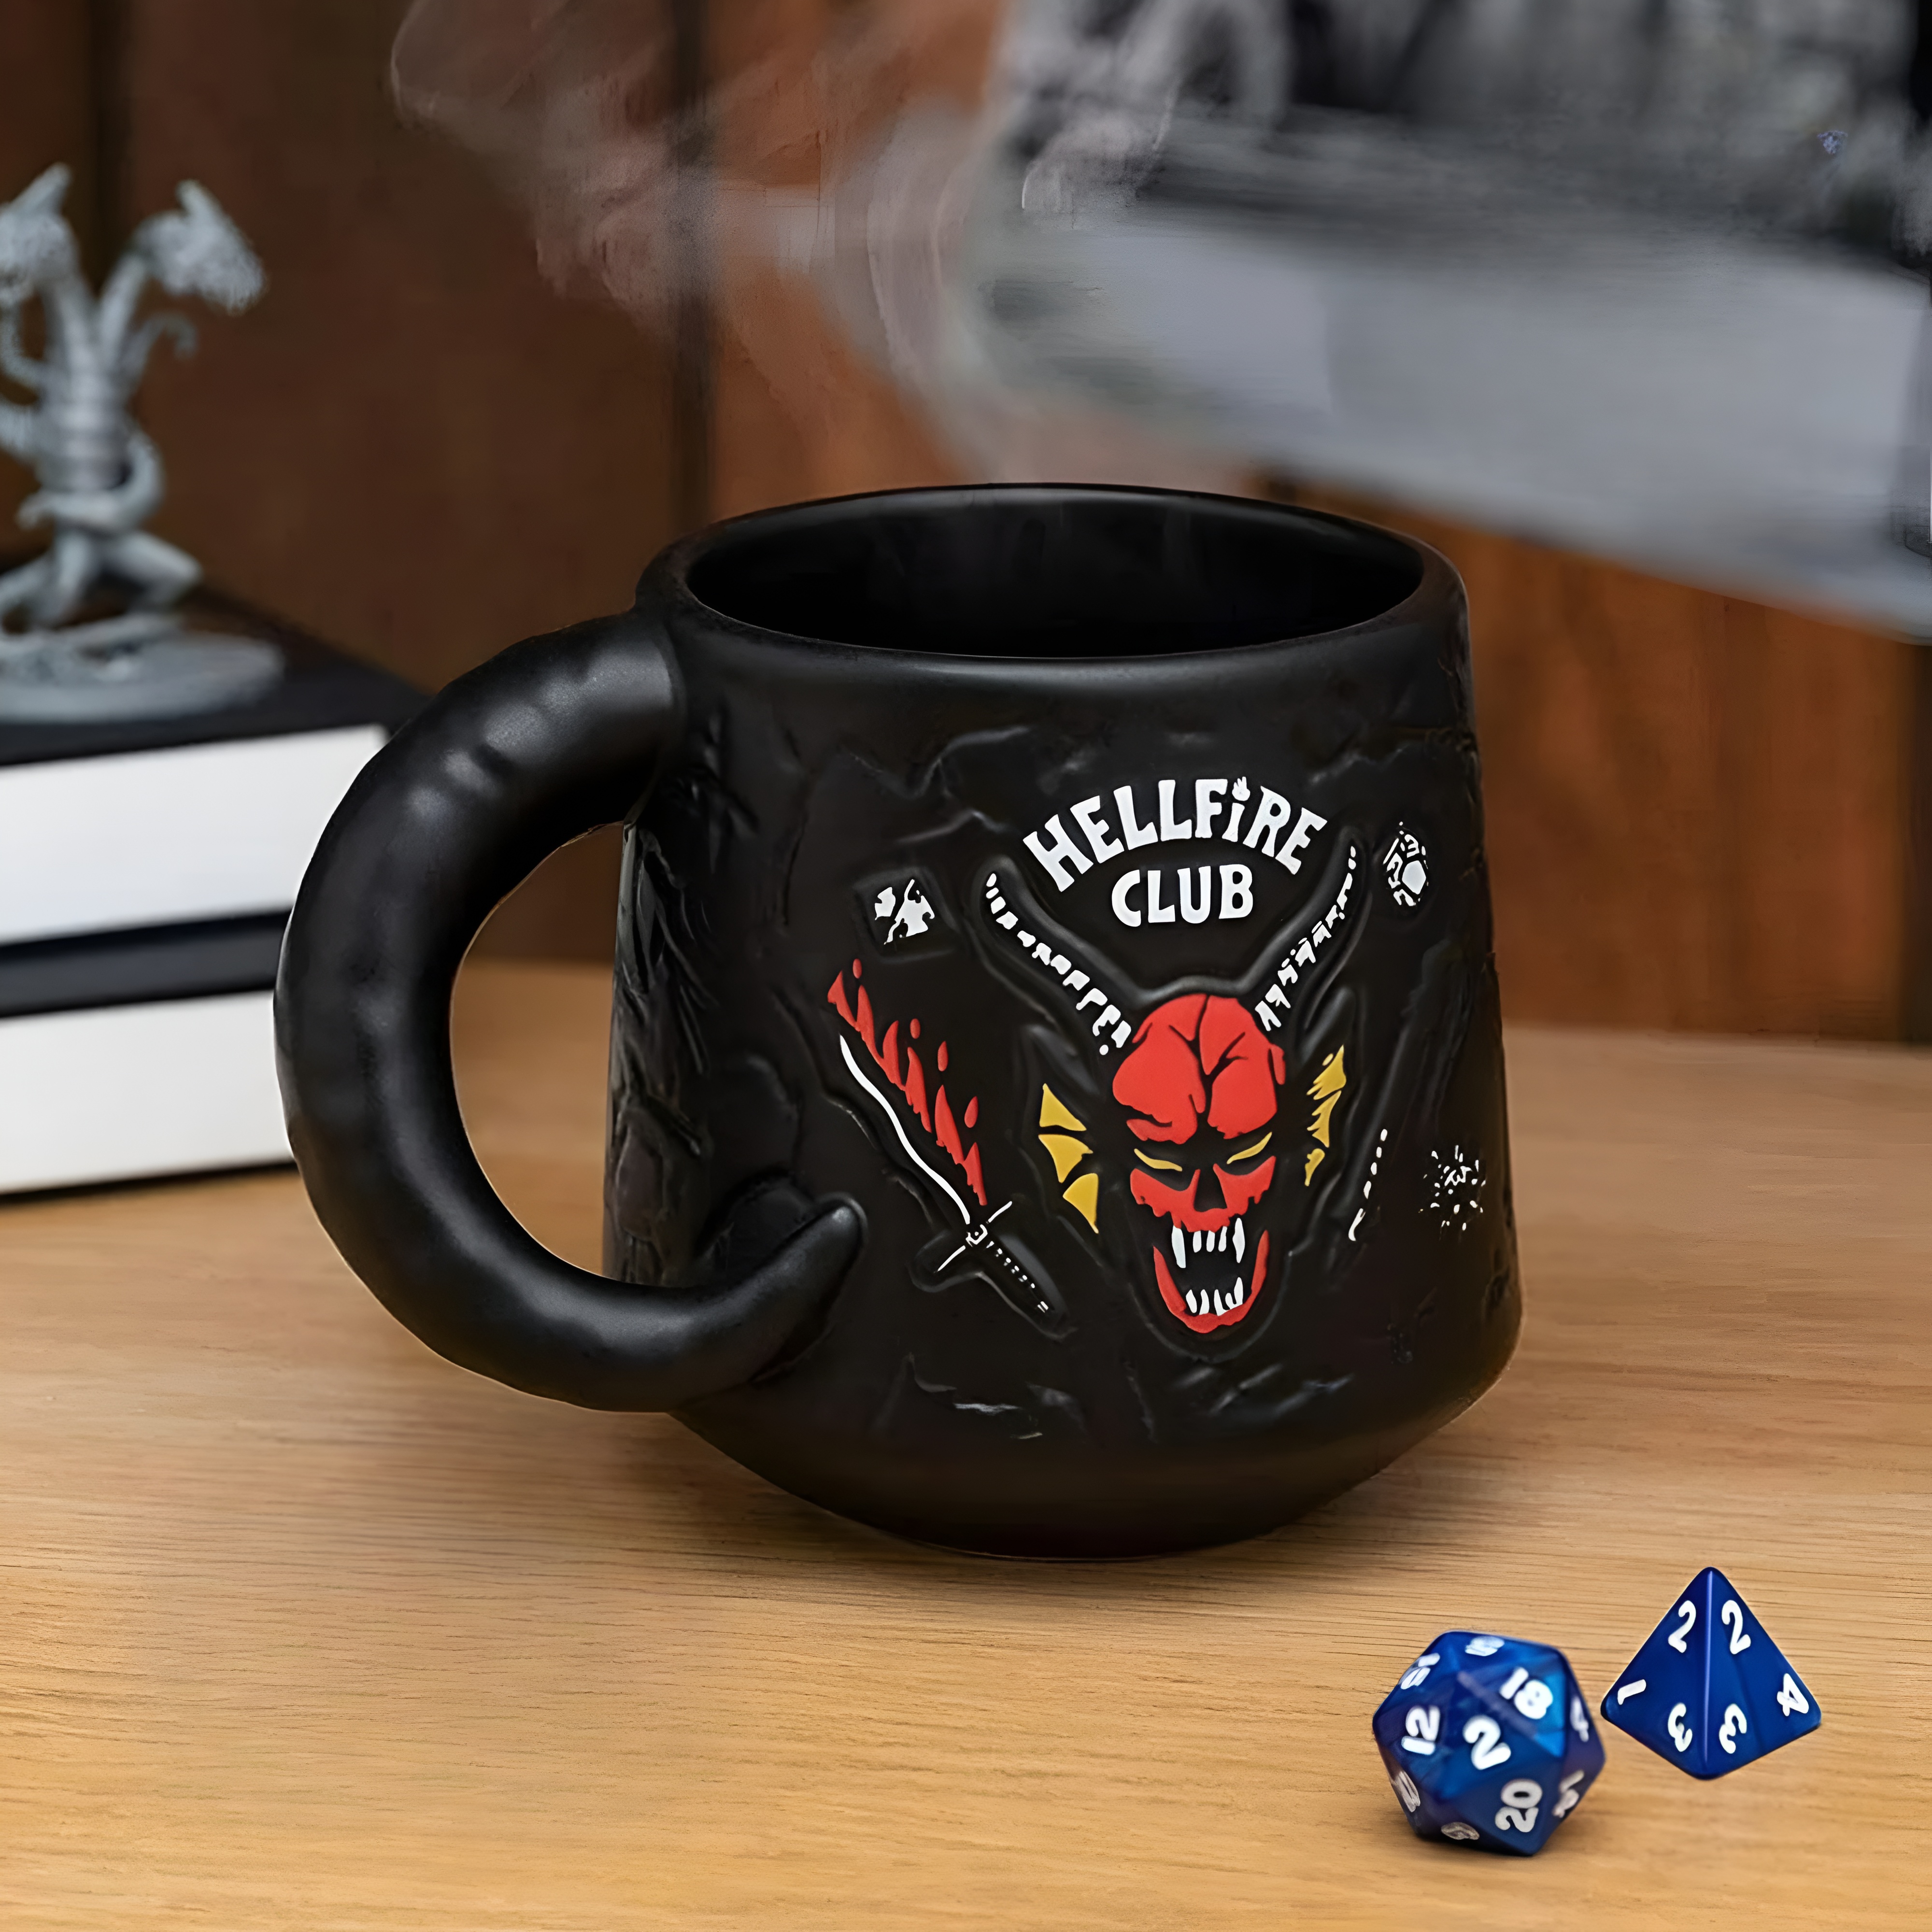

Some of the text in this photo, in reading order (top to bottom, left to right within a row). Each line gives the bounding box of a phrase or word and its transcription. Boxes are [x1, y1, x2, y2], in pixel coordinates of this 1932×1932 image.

[1111, 864, 1253, 927] CLUB
[1668, 1600, 1696, 1653] 2
[1721, 1600, 1751, 1655] 2
[1499, 1666, 1553, 1719] 18
[1617, 1678, 1647, 1705] 1
[1776, 1673, 1809, 1717] 4
[1401, 1705, 1440, 1755] 12
[1463, 1715, 1511, 1770] 2
[1667, 1702, 1693, 1752] 3
[1719, 1703, 1747, 1754] 3
[1495, 1778, 1543, 1833] 20
